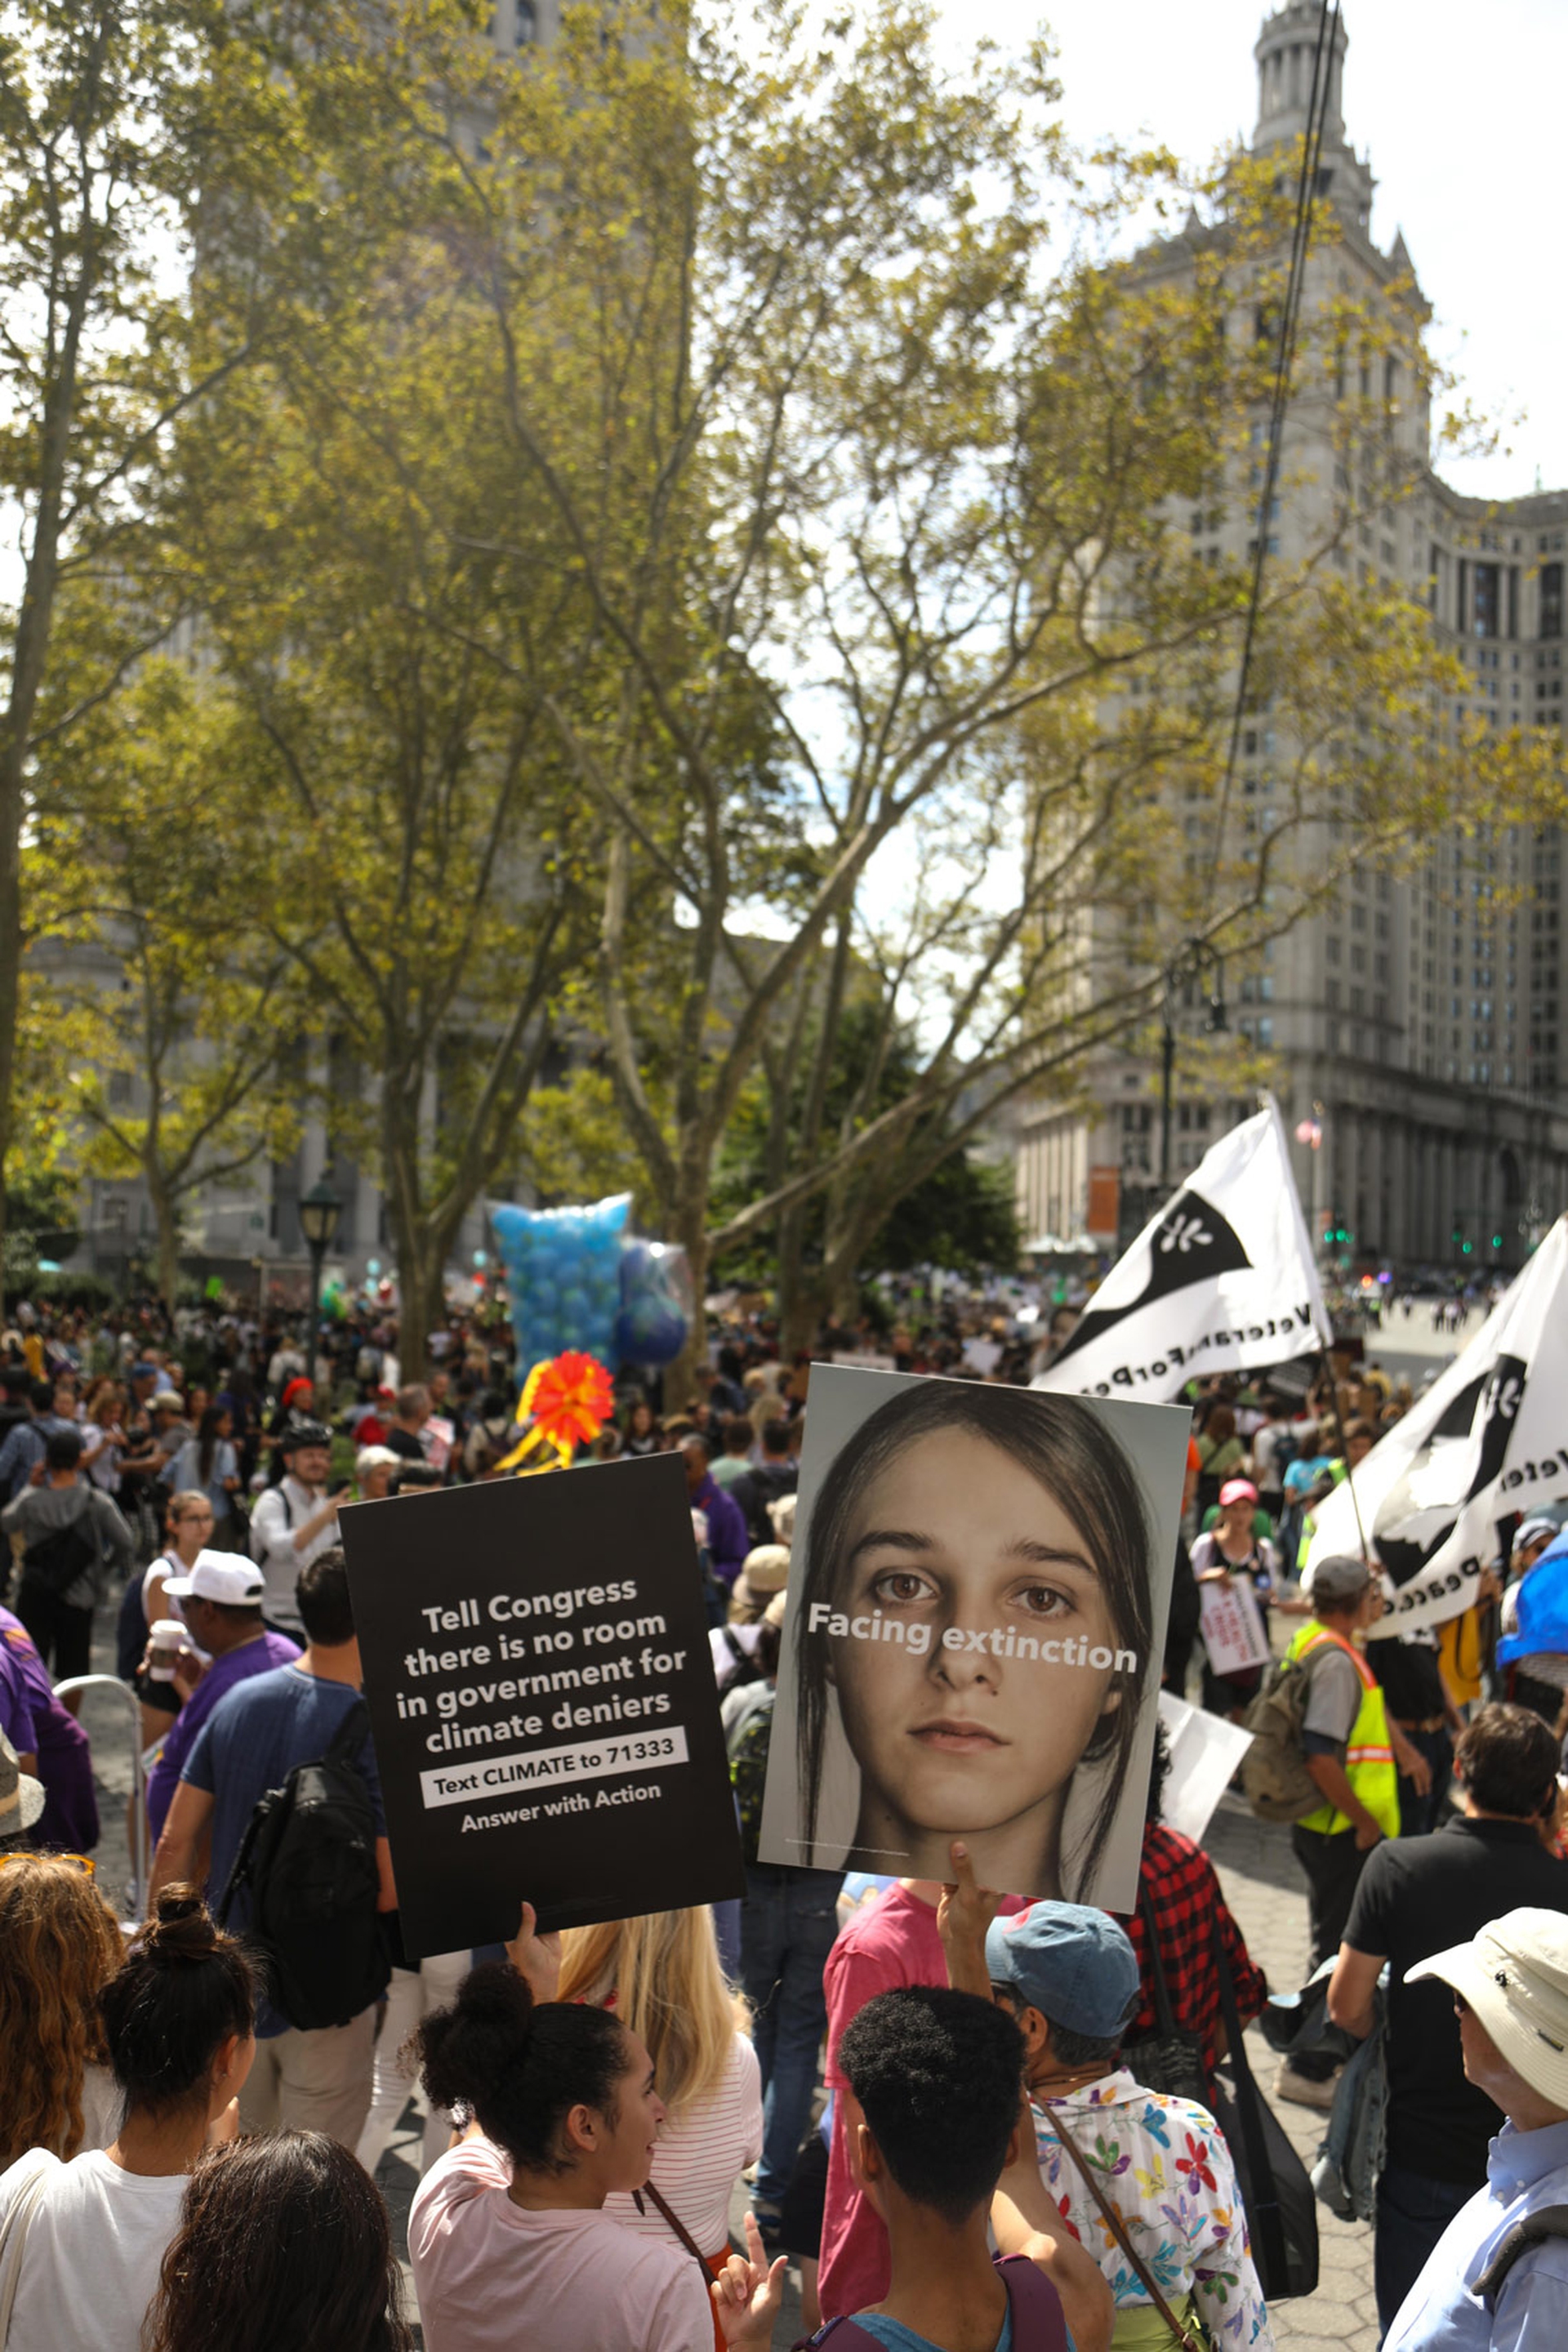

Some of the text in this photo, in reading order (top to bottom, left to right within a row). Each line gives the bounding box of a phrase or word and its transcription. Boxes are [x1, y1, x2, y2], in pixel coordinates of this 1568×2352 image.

[421, 1580, 637, 1633] Tell Congress
[404, 1615, 666, 1677] there is no room
[808, 1604, 1136, 1673] Facing extinction
[396, 1647, 686, 1719] in government for
[425, 1694, 670, 1753] climate deniers
[433, 1737, 675, 1796] Text CLIMATE to 71333
[461, 1783, 662, 1833] Answer with Action
